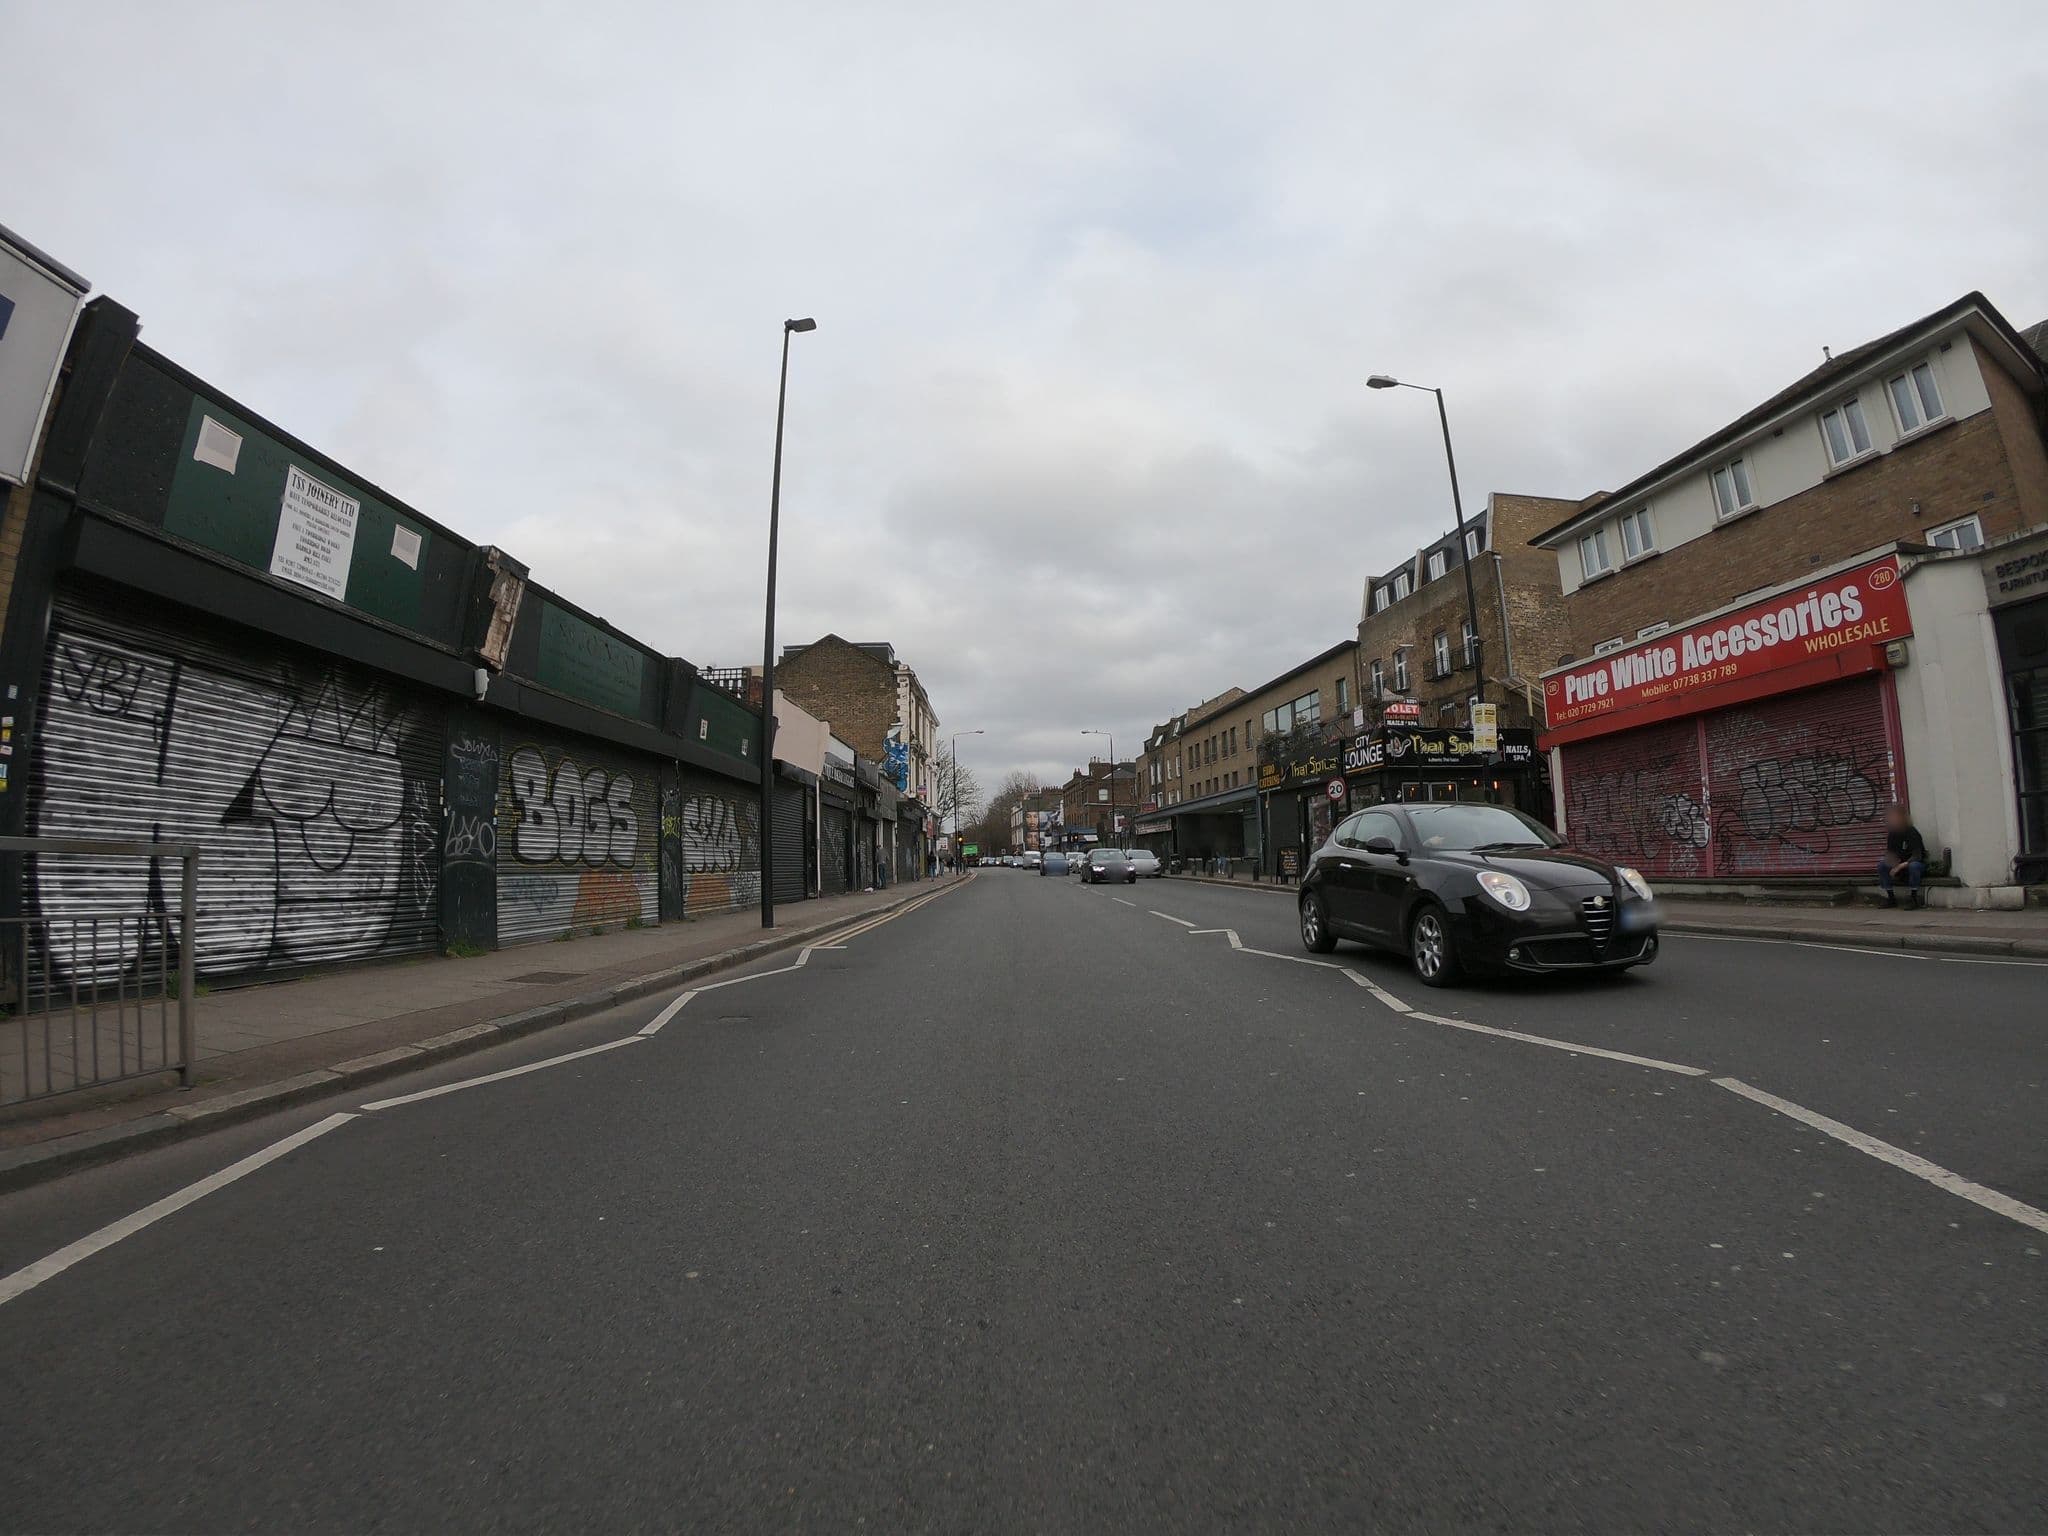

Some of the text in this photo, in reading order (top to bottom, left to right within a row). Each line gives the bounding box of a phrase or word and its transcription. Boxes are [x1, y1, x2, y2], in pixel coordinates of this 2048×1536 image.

[292, 474, 355, 518] TSS JOINERY LTD
[1996, 549, 2048, 578] BESPOK
[1874, 571, 1890, 585] 280
[1999, 569, 2048, 593] FURNITU
[1565, 585, 1863, 705] Pure White Accessories
[1804, 616, 1890, 654] WHOLESALE
[1641, 663, 1737, 698] Mobile: 07738 337 789
[1400, 704, 1417, 714] LET
[1556, 697, 1615, 721] Tel: 020 7729 7921
[1355, 734, 1370, 749] CITY
[1410, 734, 1474, 757] Thai Spi
[1506, 745, 1528, 754] NAILS
[1345, 744, 1383, 769] LOUNGE
[1329, 784, 1343, 794] 20
